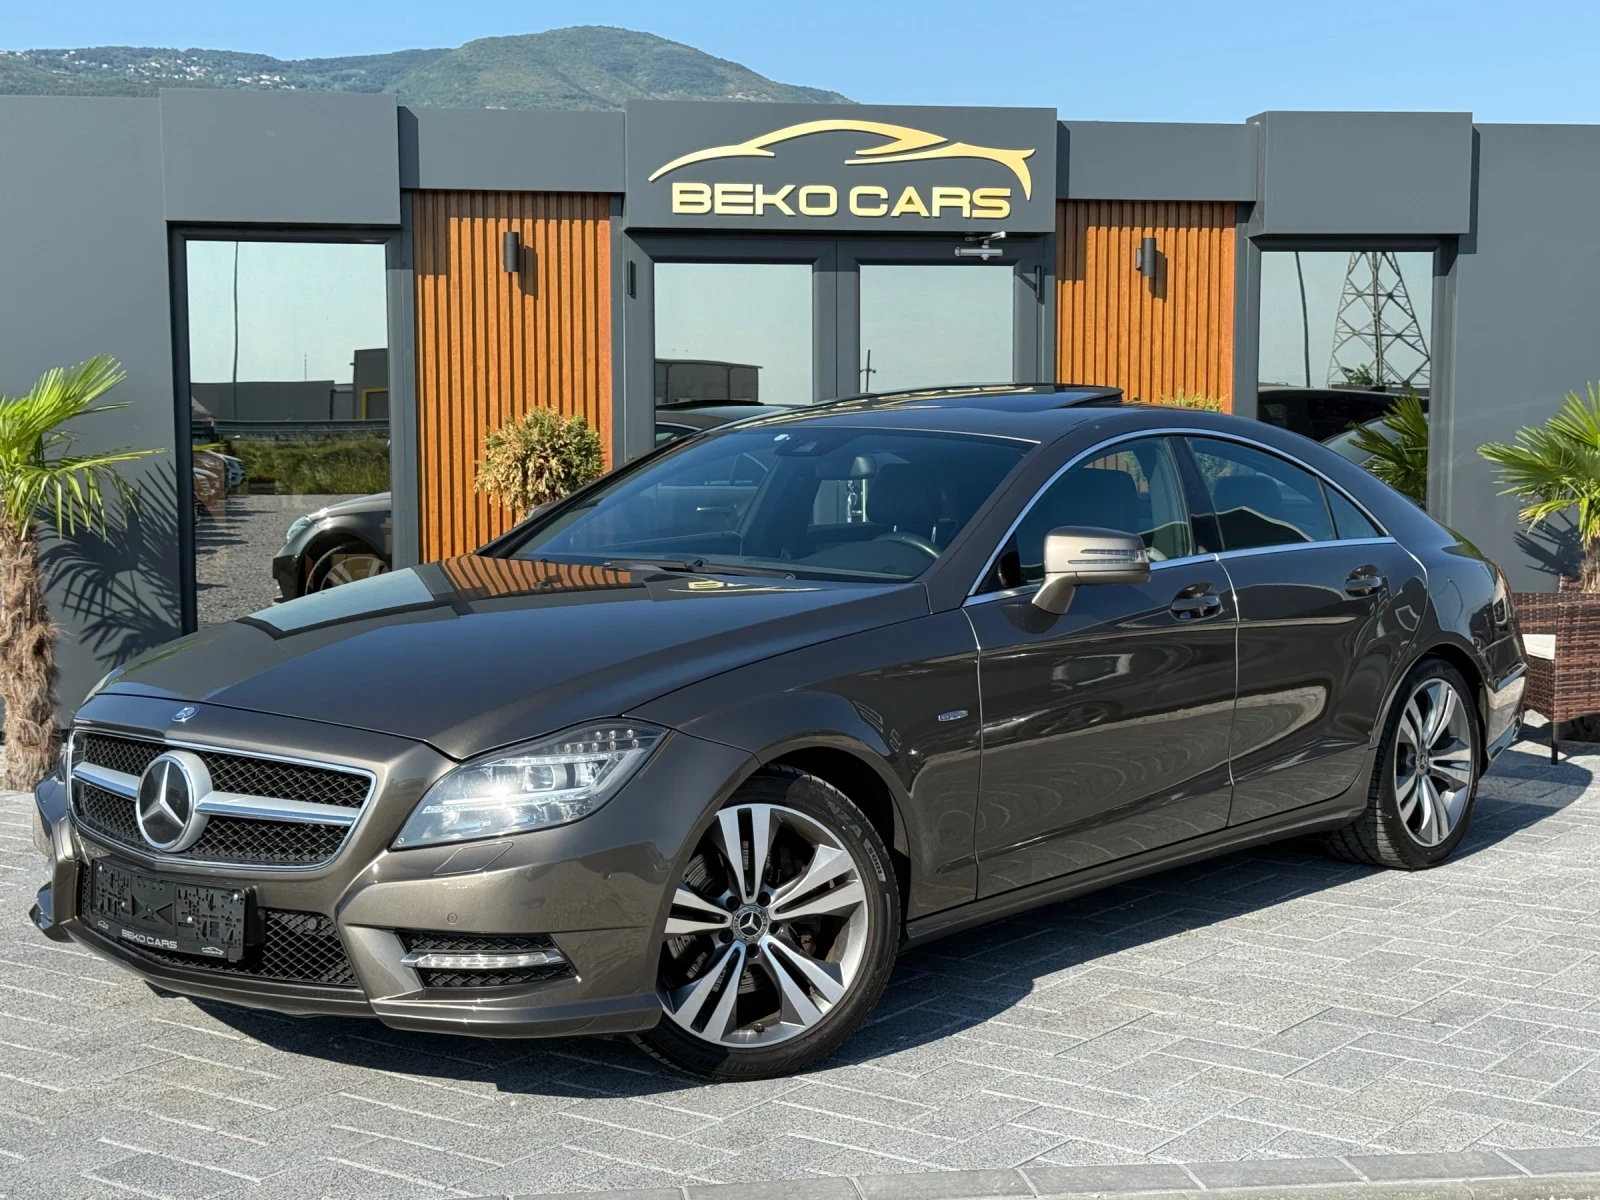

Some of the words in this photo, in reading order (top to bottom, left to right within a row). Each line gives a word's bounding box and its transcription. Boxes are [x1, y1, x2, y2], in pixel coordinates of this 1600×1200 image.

[672, 182, 839, 217] BEKO
[848, 185, 1012, 219] CARS
[121, 929, 146, 944] BEKO
[147, 936, 178, 949] CARS
